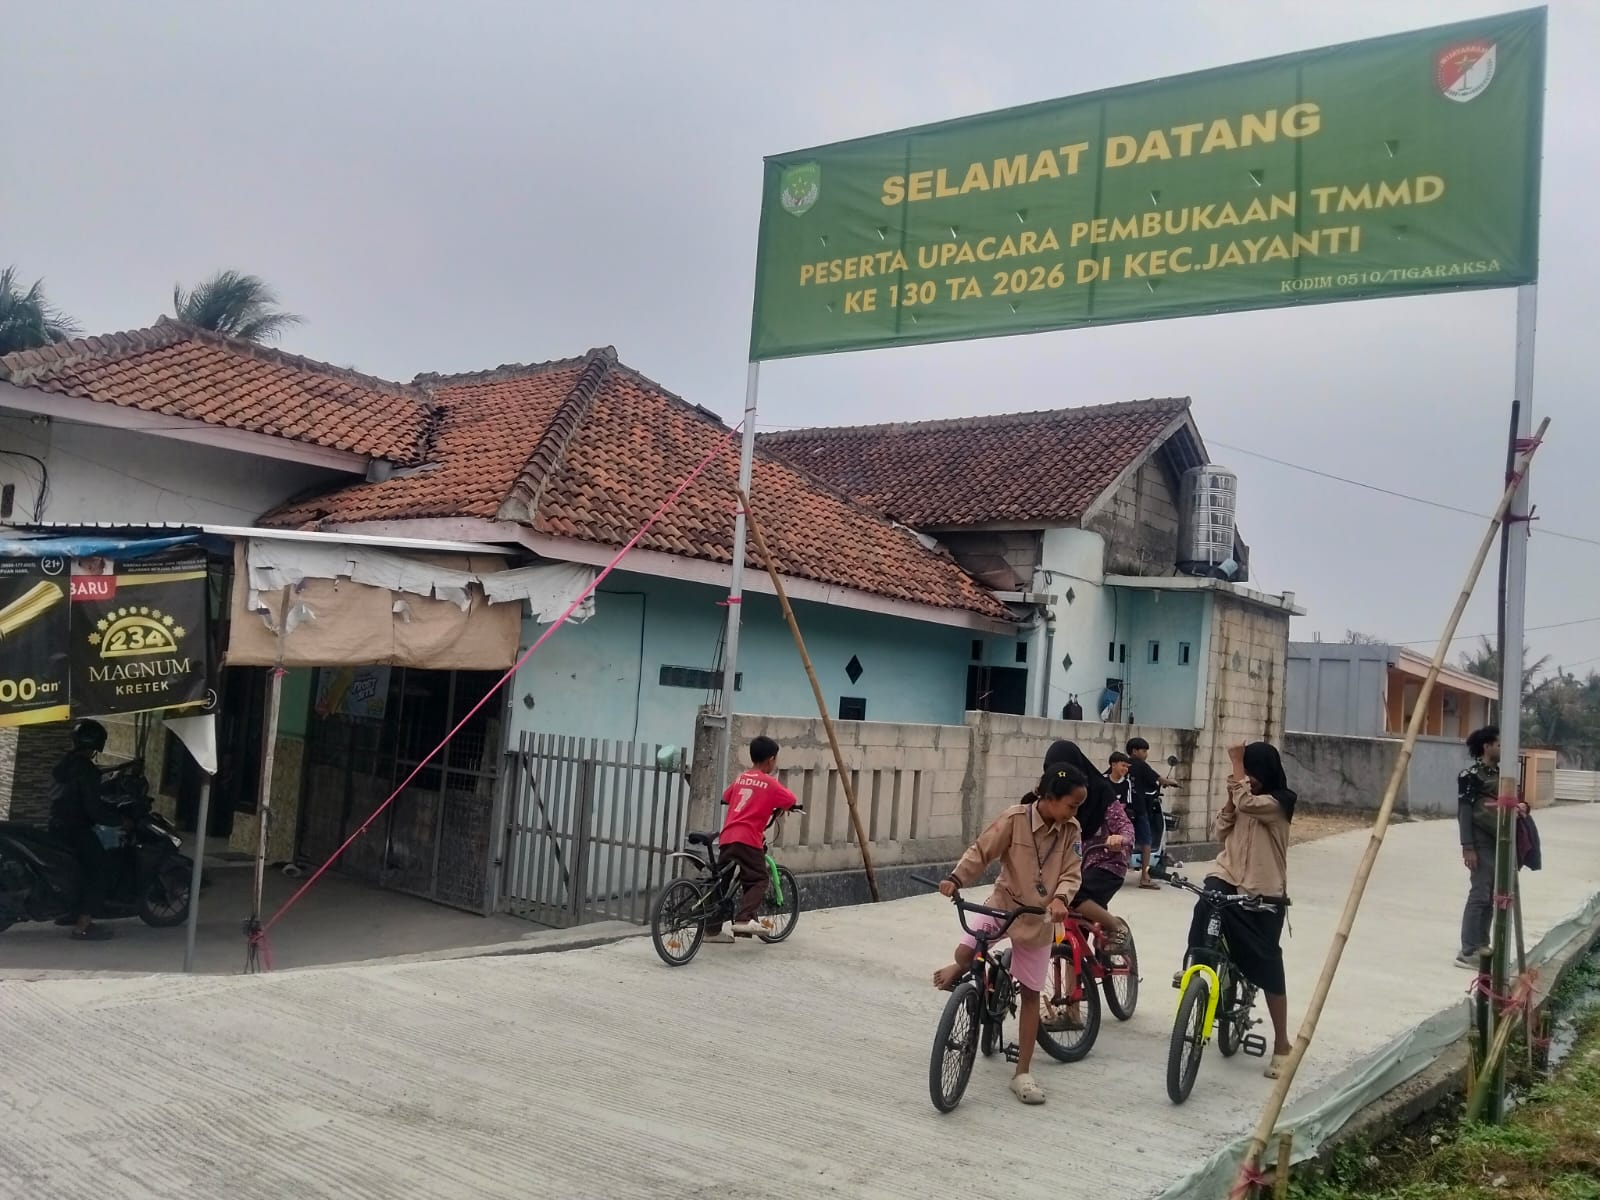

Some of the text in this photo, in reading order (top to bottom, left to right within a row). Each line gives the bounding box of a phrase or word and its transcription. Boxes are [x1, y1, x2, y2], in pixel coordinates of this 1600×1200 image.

[881, 102, 1321, 207] SELAMAT DATANG
[799, 175, 1445, 286] PESERTA UPACARA PEMBUKAAN TMMD
[844, 225, 1362, 314] KE 130 TA 2026 DI KEC.JAYANTI
[1280, 258, 1501, 293] KODIM 0510/TIGARAKSA
[44, 559, 61, 568] 21+
[70, 581, 109, 597] BARU
[110, 625, 167, 651] 234
[88, 657, 192, 682] MAGNUM
[115, 681, 170, 696] KRETEK
[733, 787, 754, 813] 7
